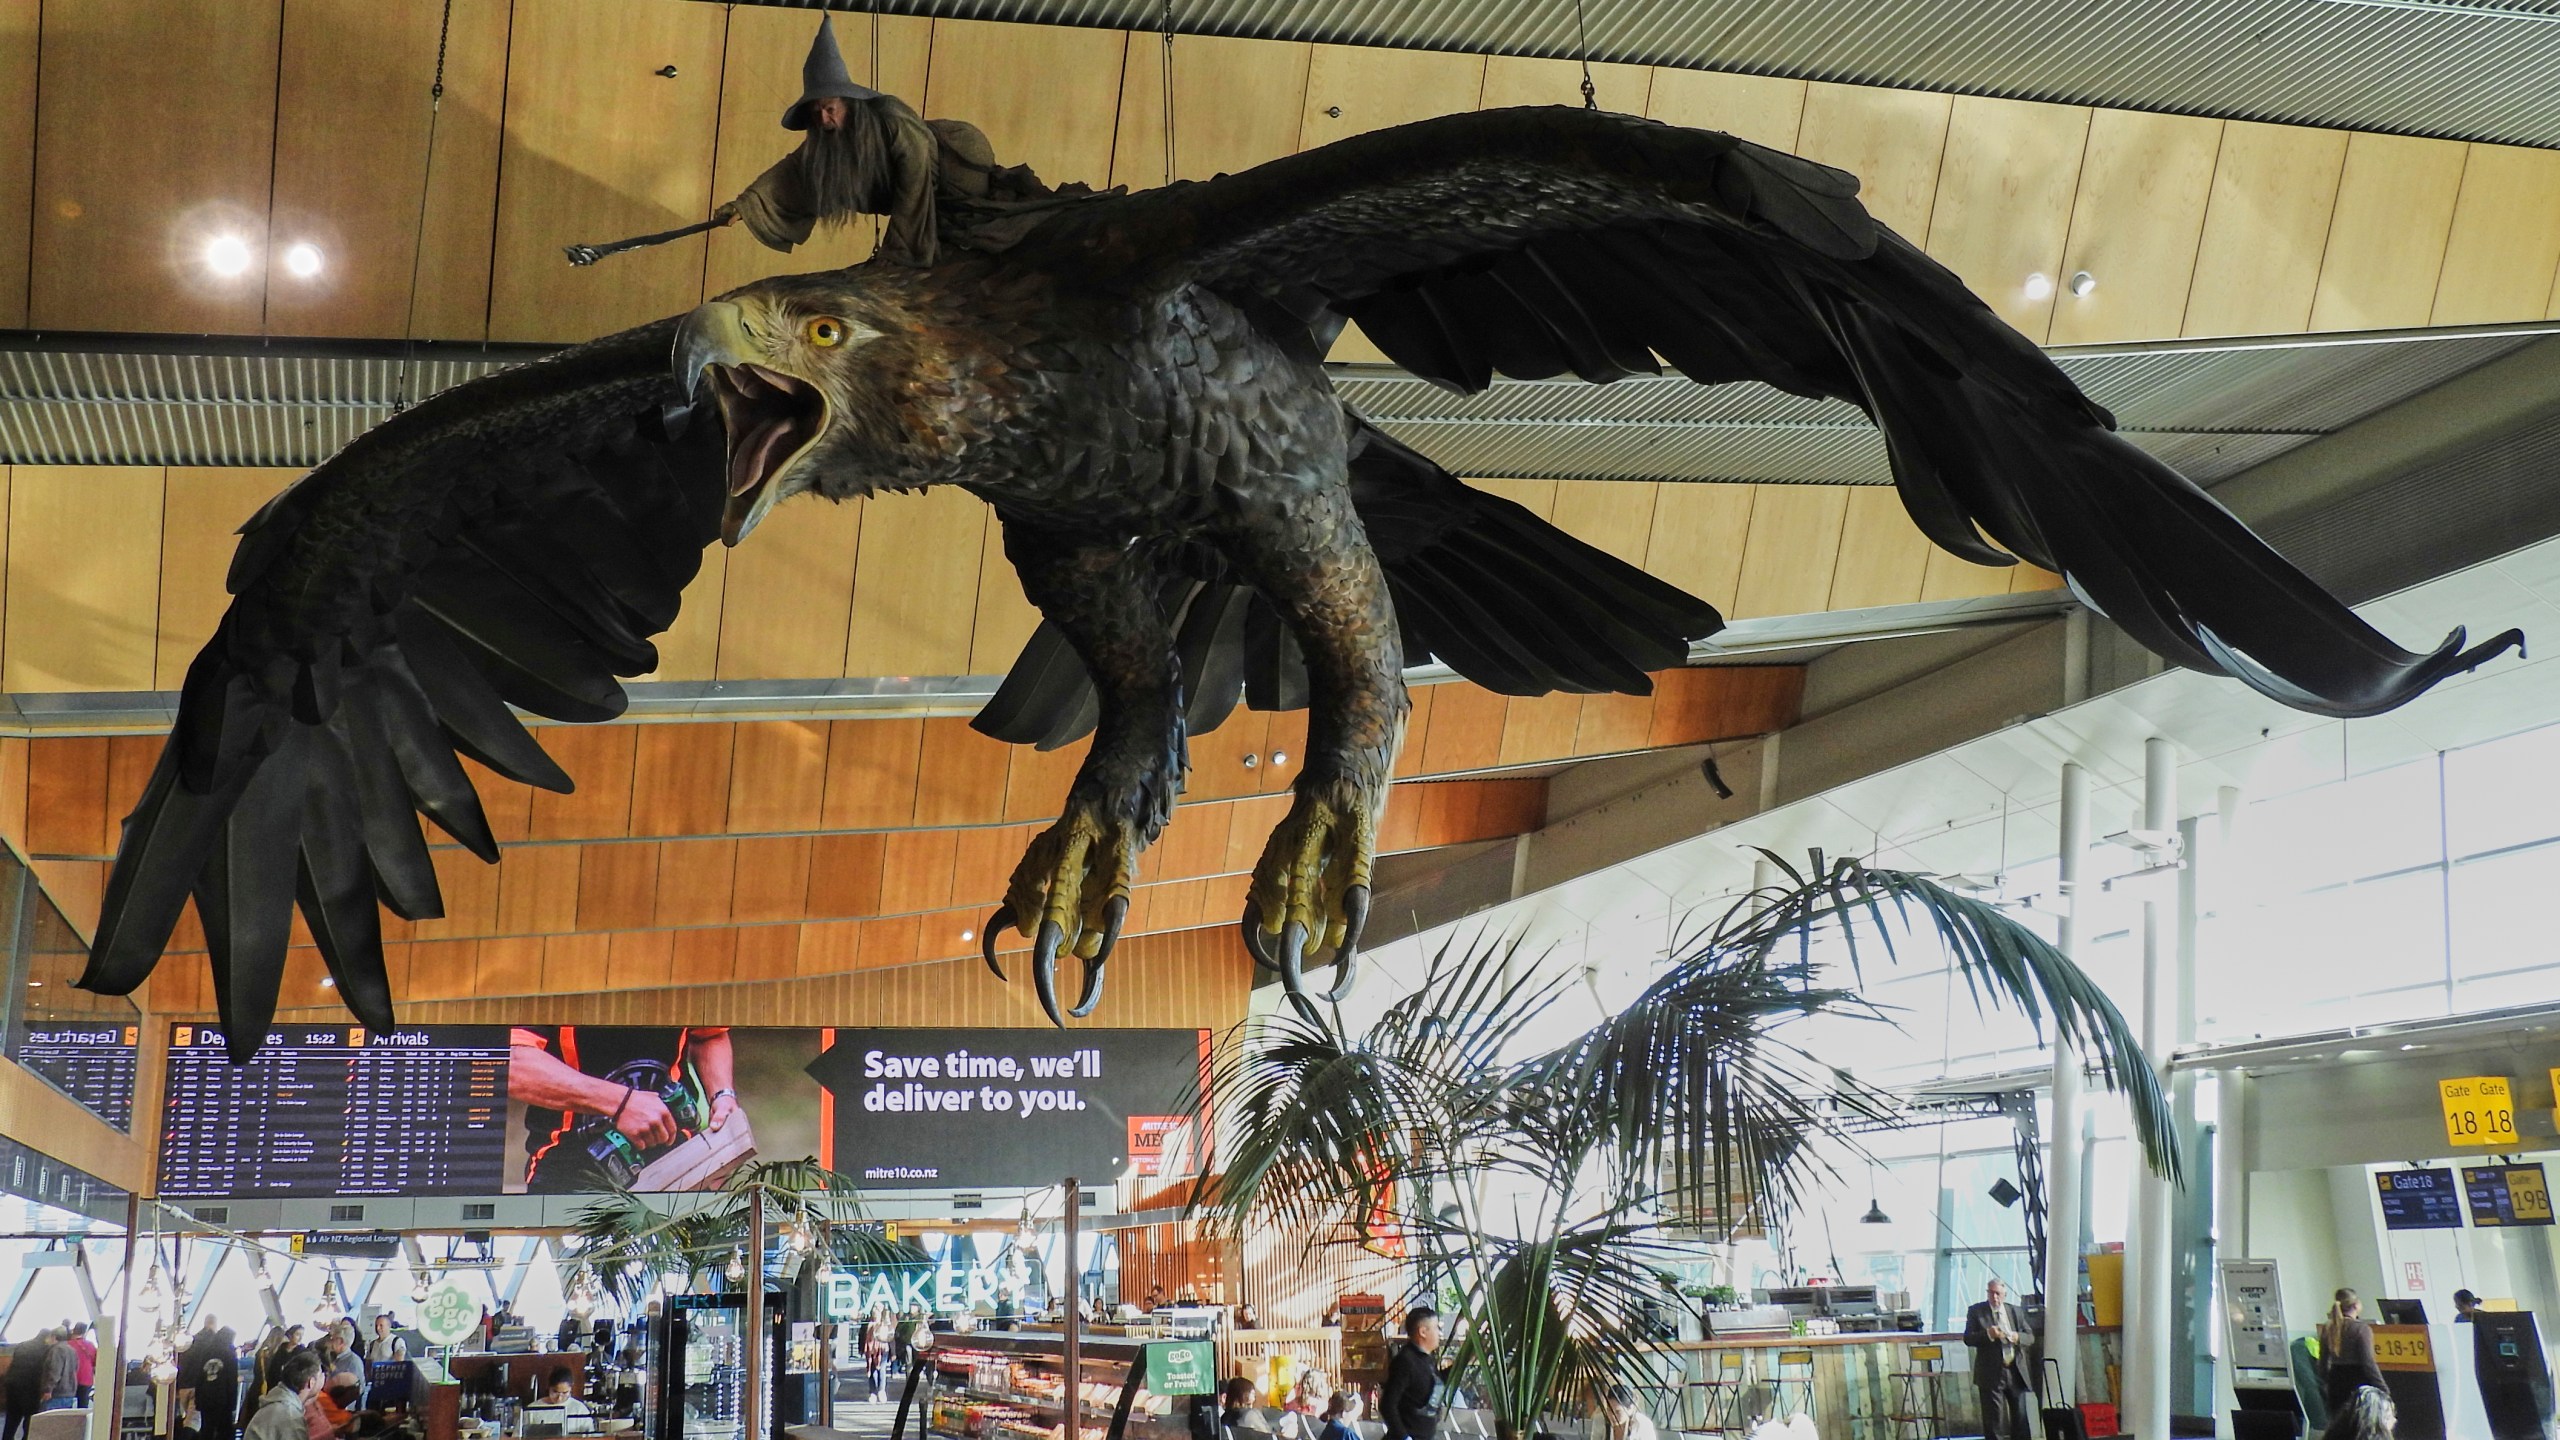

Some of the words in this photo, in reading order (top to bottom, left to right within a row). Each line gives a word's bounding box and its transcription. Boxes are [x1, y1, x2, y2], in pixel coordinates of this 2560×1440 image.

[305, 1034, 336, 1045] 15:22
[864, 1050, 940, 1078] Save
[944, 1049, 1025, 1082] time,
[2444, 1085, 2471, 1098] Gate
[2480, 1082, 2505, 1095] Gate
[863, 1082, 975, 1112] deliver
[980, 1085, 1013, 1112] to
[1018, 1089, 1087, 1119] you.
[2450, 1110, 2478, 1136] 18
[2485, 1109, 2512, 1133] 18
[864, 1166, 938, 1180] mitre10.co.nz
[2507, 1173, 2532, 1186] Gate
[2512, 1190, 2549, 1212] 19B
[319, 1235, 330, 1243] Air
[332, 1235, 342, 1243] NZ
[343, 1234, 372, 1245] Regional
[373, 1234, 402, 1246] Lounge
[828, 1268, 1033, 1317] BAKERY
[2240, 1286, 2268, 1295] carry
[429, 1292, 458, 1318] go
[442, 1307, 473, 1330] go
[2386, 1340, 2426, 1357] 18-19
[1169, 1351, 1191, 1361] gogo
[1166, 1372, 1196, 1380] Toasted
[1174, 1380, 1199, 1389] Fresh?
